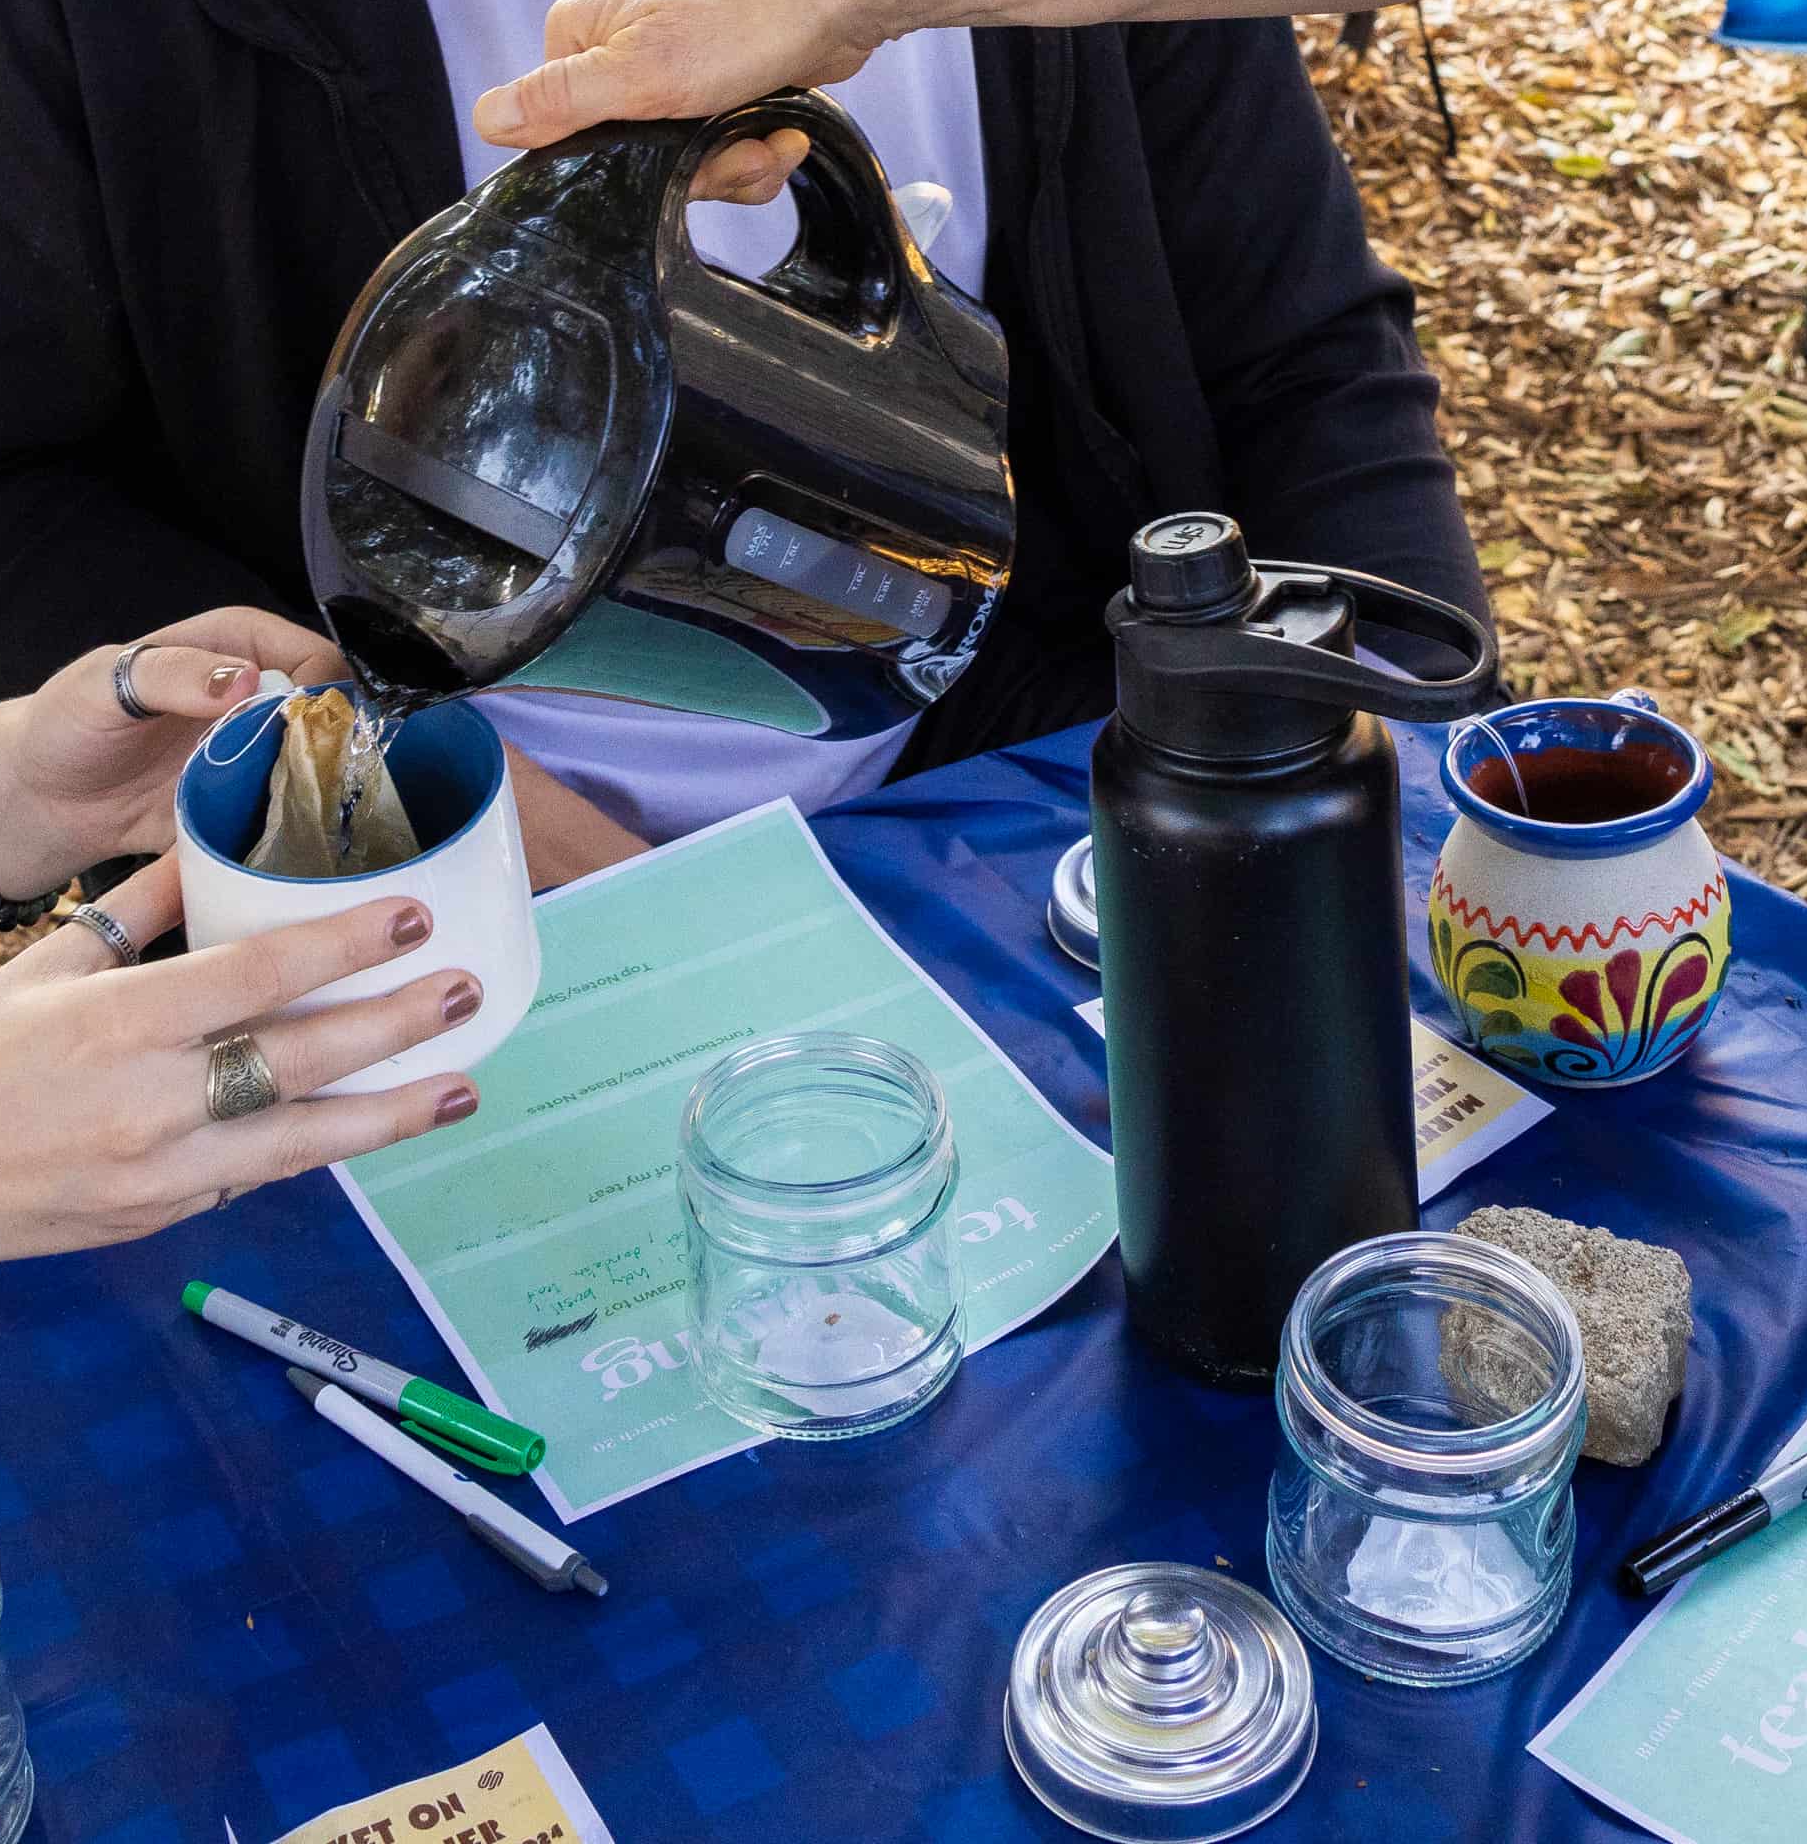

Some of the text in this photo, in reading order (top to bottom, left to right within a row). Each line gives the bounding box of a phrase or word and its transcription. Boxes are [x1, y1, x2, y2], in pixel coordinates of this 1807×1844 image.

[744, 523, 765, 557] MAX
[618, 957, 653, 981] Top
[524, 1023, 755, 1119] Functional Herbs/Base Notes
[585, 1161, 674, 1204] of my tea?
[960, 1195, 1044, 1247] te
[602, 1276, 687, 1317] drawn to?
[298, 1330, 362, 1373] Sharpie
[615, 1409, 678, 1445] March
[409, 1792, 466, 1830] ON
